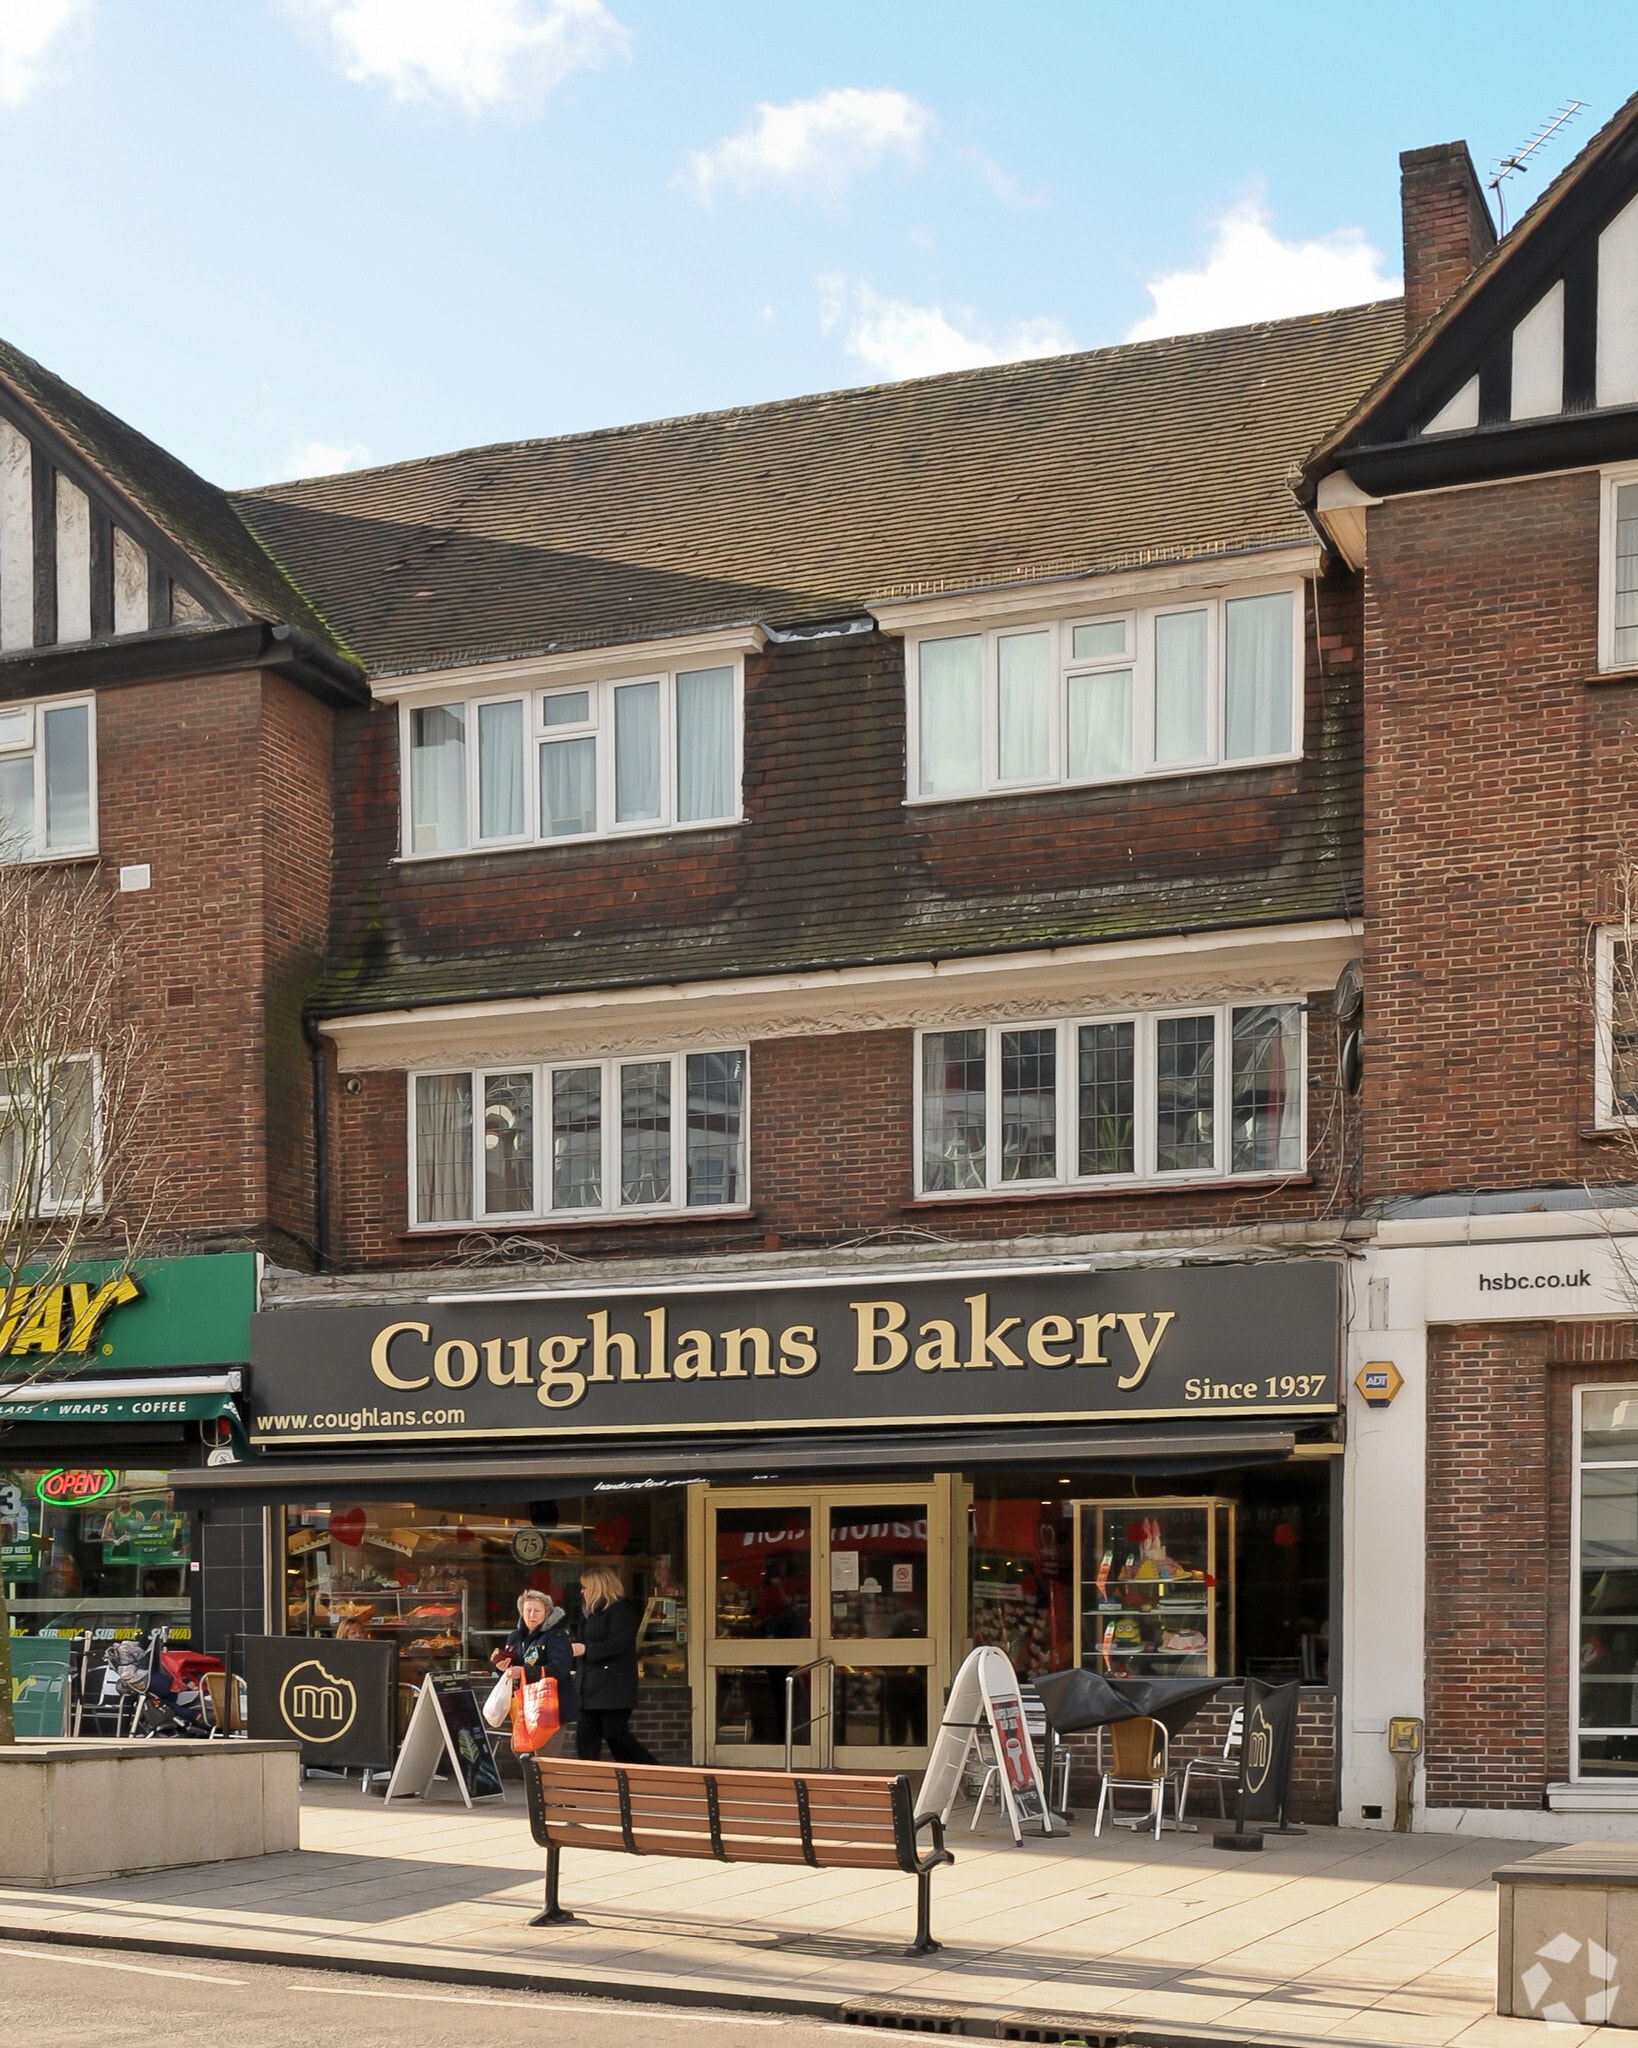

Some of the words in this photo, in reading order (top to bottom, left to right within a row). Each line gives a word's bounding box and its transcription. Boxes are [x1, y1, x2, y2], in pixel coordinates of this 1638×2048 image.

[1479, 1268, 1591, 1291] hsbc.co.uk
[370, 1306, 820, 1408] Coughlans
[849, 1292, 1176, 1390] Bakery
[1184, 1377, 1258, 1401] Since
[1264, 1374, 1327, 1398] 1937
[59, 1404, 109, 1415] WRAPS
[131, 1401, 187, 1414] COFFEE
[256, 1406, 466, 1430] www.coughlans.com
[46, 1472, 103, 1495] OPEN
[521, 1538, 538, 1553] 75
[92, 1628, 142, 1640] SUBWAY
